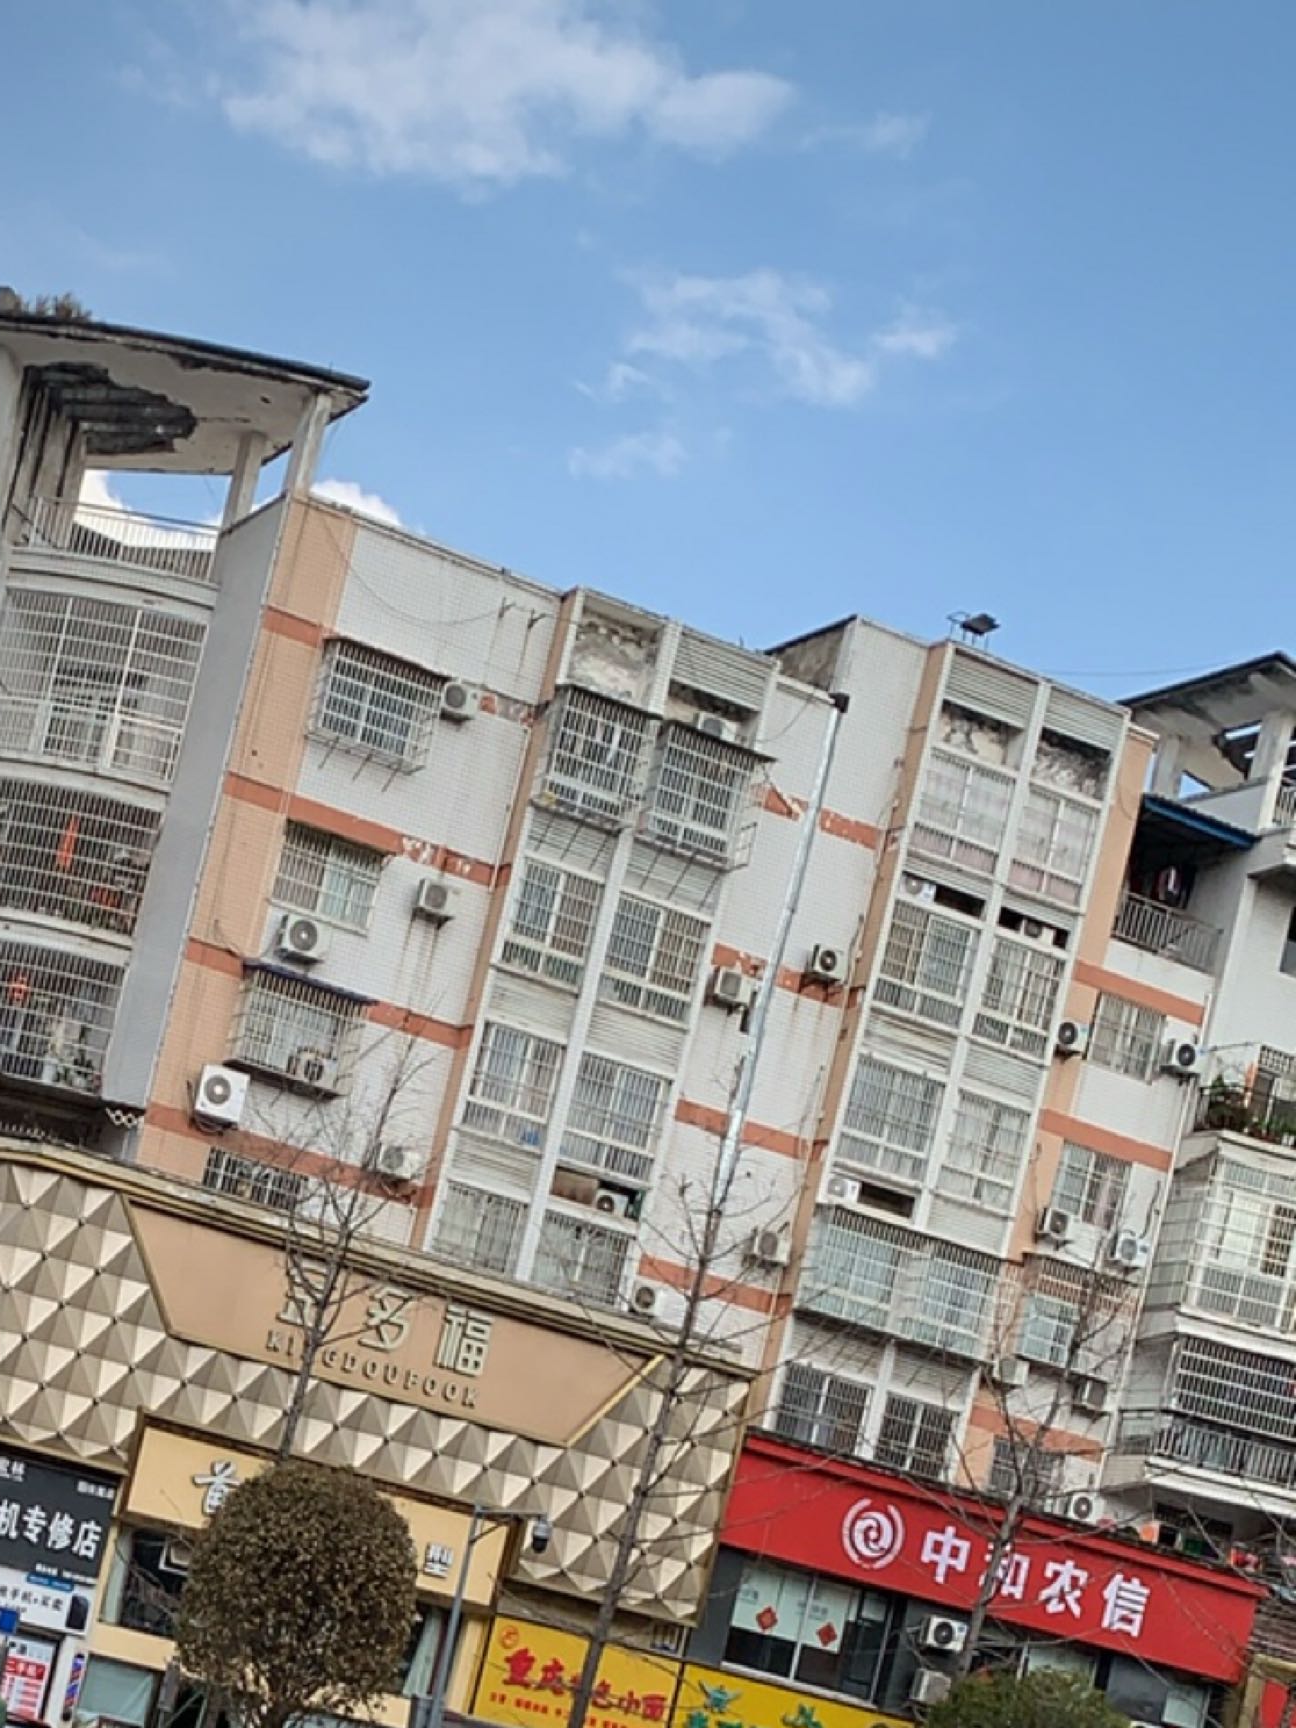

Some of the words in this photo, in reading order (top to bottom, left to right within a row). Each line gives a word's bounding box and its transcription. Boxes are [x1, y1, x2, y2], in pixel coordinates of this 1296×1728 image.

[265, 1328, 477, 1409] KIGDOUFOOK
[920, 1526, 1151, 1638] 中和农信
[502, 1648, 667, 1721] 重庆色小面
